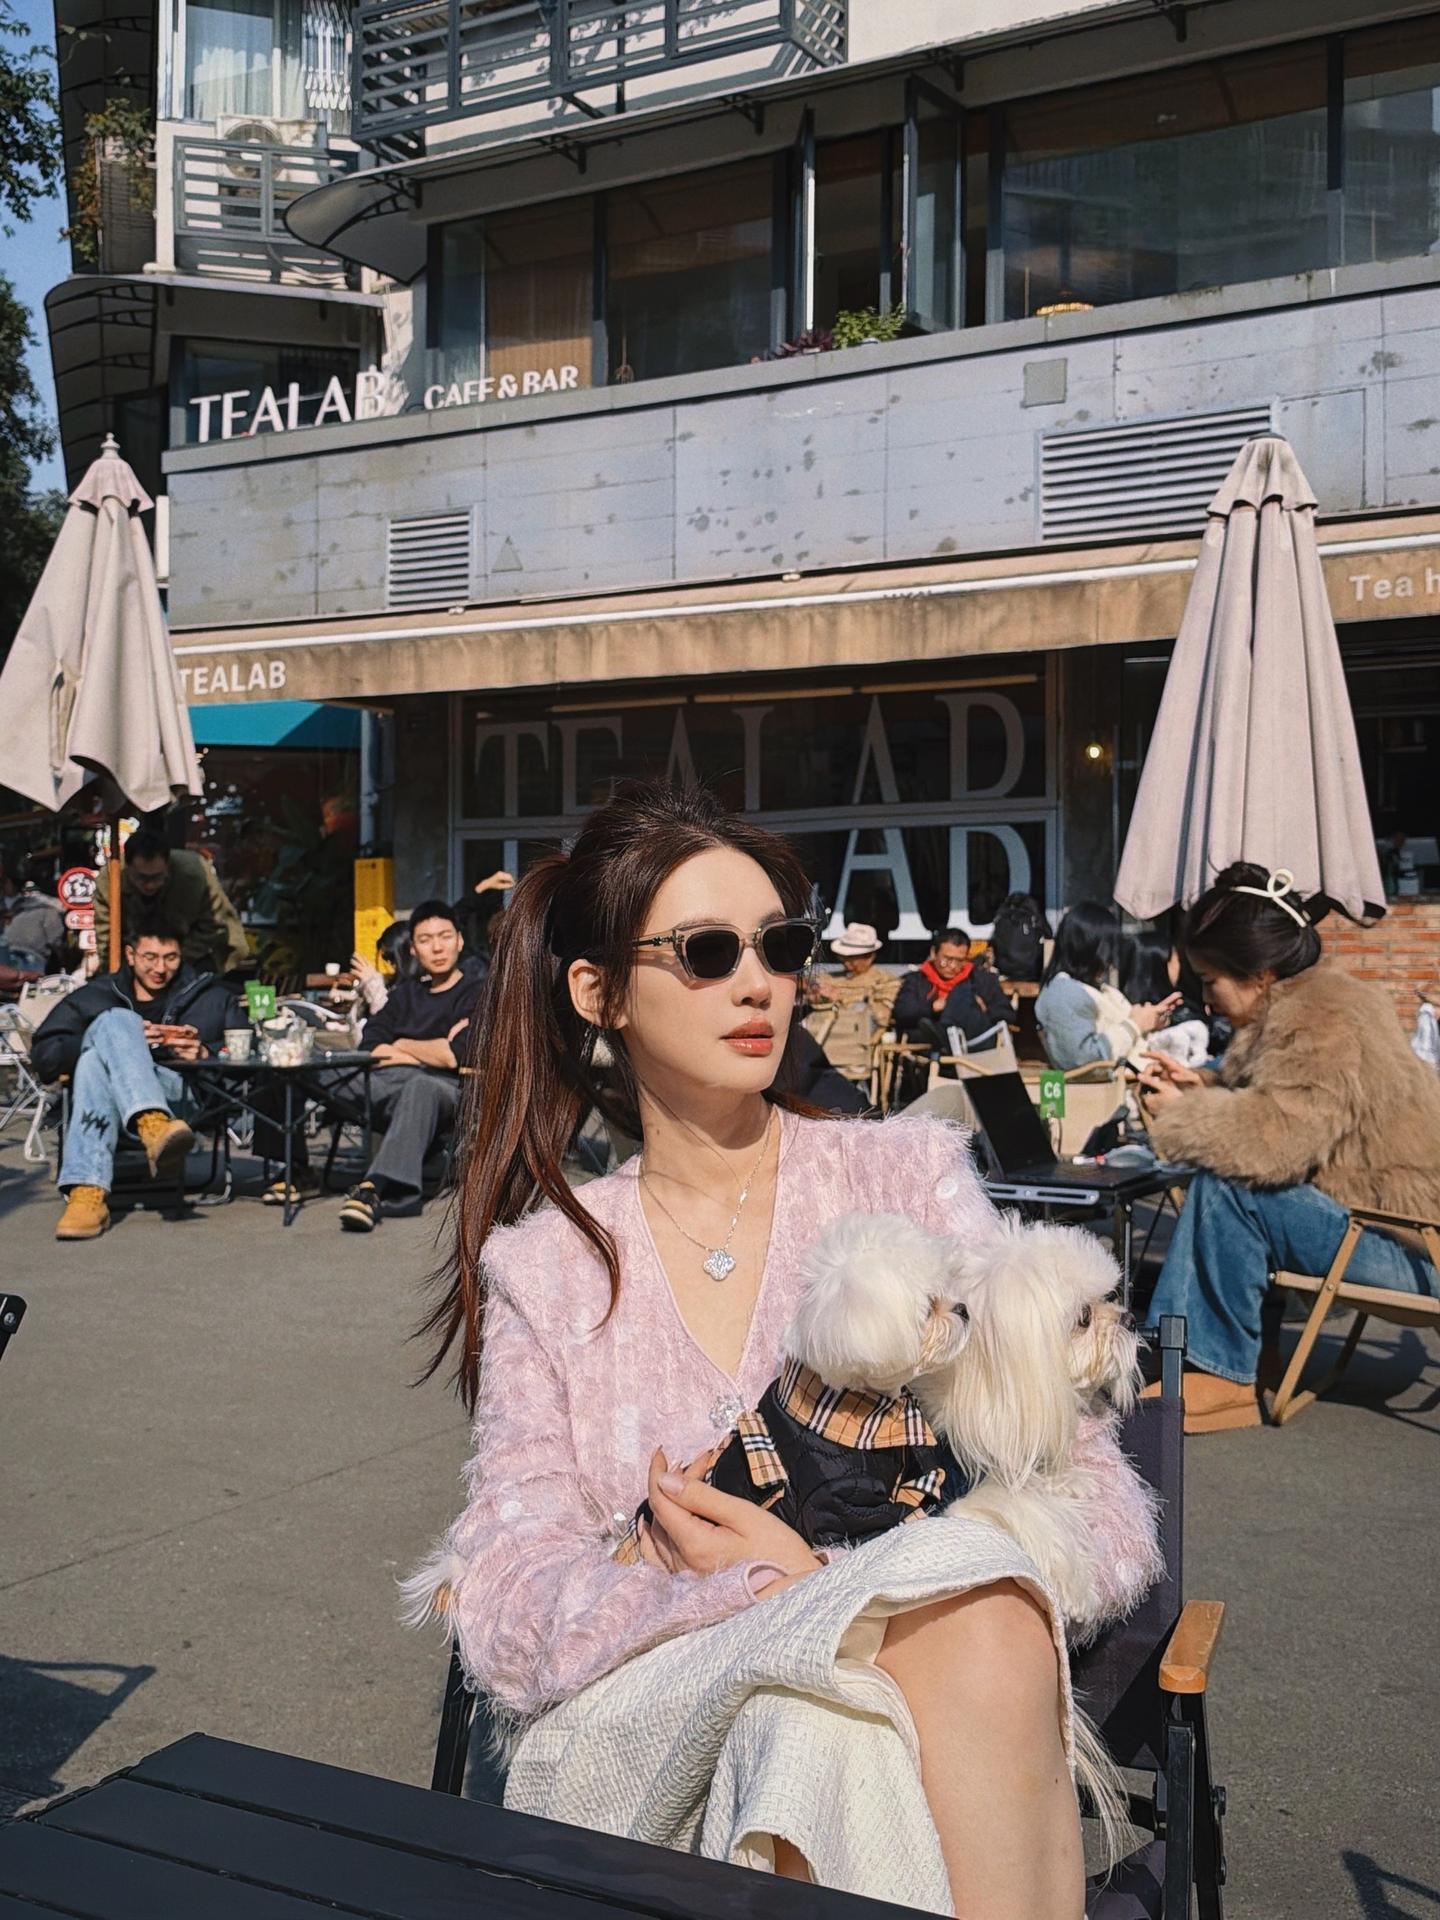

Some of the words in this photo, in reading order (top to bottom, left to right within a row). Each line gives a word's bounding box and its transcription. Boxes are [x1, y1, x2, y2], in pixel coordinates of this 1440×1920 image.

[522, 365, 579, 396] BAR
[189, 369, 388, 443] TEALAB
[1348, 574, 1414, 602] Tea
[179, 660, 287, 696] TEALAB
[1044, 1081, 1062, 1099] C6
